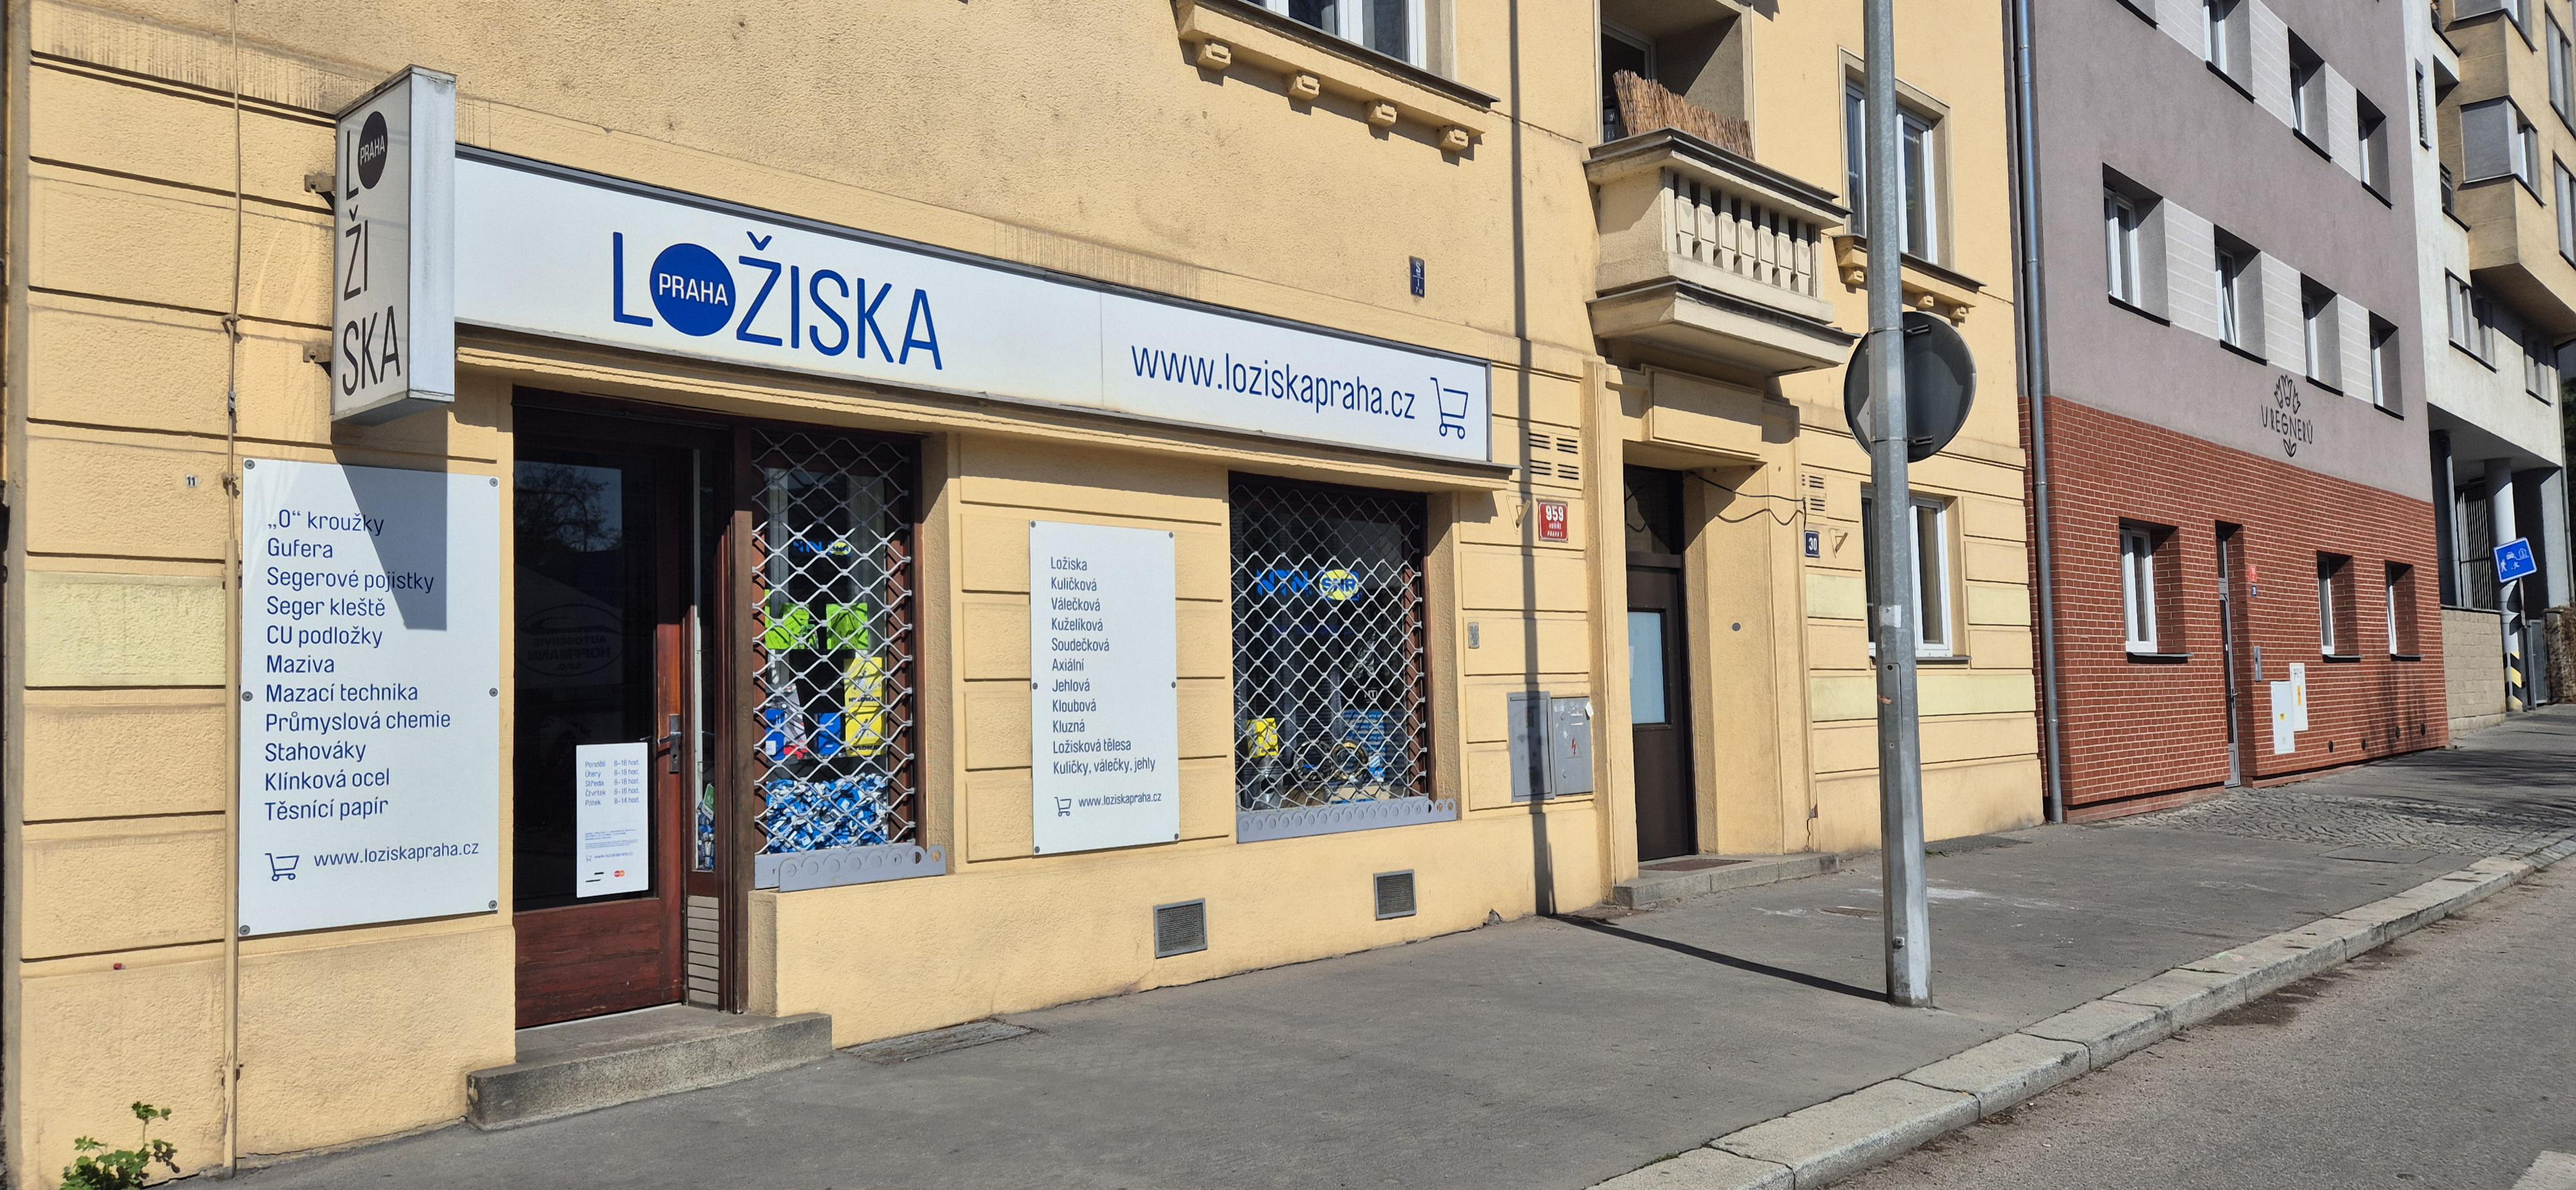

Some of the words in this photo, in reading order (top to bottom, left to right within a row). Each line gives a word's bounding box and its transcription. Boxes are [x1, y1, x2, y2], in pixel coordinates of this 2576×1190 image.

[360, 135, 385, 166] PRAHA
[344, 204, 368, 302] ŽI
[658, 272, 728, 306] PRAHA
[342, 306, 401, 396] SKA
[1131, 345, 1415, 420] www.loziskapraha.cz
[2261, 404, 2268, 428] U
[187, 476, 195, 486] 11
[308, 511, 384, 536] kroužky
[1545, 506, 1564, 522] 959
[268, 538, 333, 558] Gufera
[1808, 537, 1818, 550] 30
[1051, 556, 1087, 571] Ložiska
[267, 566, 359, 592] Segerové
[365, 571, 434, 594] pojistky
[1051, 576, 1097, 591] Kuličková
[1257, 570, 1308, 596] NTN
[267, 596, 325, 620] Seger
[330, 598, 385, 616] kleště
[1051, 596, 1100, 612] Válečková
[1052, 617, 1103, 632] Kuželíková
[267, 625, 292, 644] CU
[299, 626, 382, 648] podložky
[1051, 637, 1109, 651] Soudečková
[267, 654, 334, 673] Maziva
[1052, 658, 1084, 672] Axiální
[267, 683, 336, 702] Mazací
[341, 683, 418, 702] technika
[1052, 678, 1090, 692] Jehlová
[1053, 698, 1096, 712] Kloubová
[266, 710, 380, 735] Průmyslová
[386, 710, 450, 729] chemie
[1053, 718, 1085, 733] Kluzná
[265, 740, 366, 762] Stahováky
[1053, 738, 1101, 754] Ložisková
[1104, 738, 1131, 751] tělesa
[1053, 760, 1091, 776] Kuličky,
[1134, 756, 1155, 773] jehly
[265, 769, 346, 791] Klínková
[352, 767, 389, 787] ocel
[264, 798, 334, 820] Těsnící
[340, 796, 388, 820] papír
[1079, 792, 1161, 807] www.loziskapraha.cz
[313, 842, 479, 866] www.loziskapraha.cz
